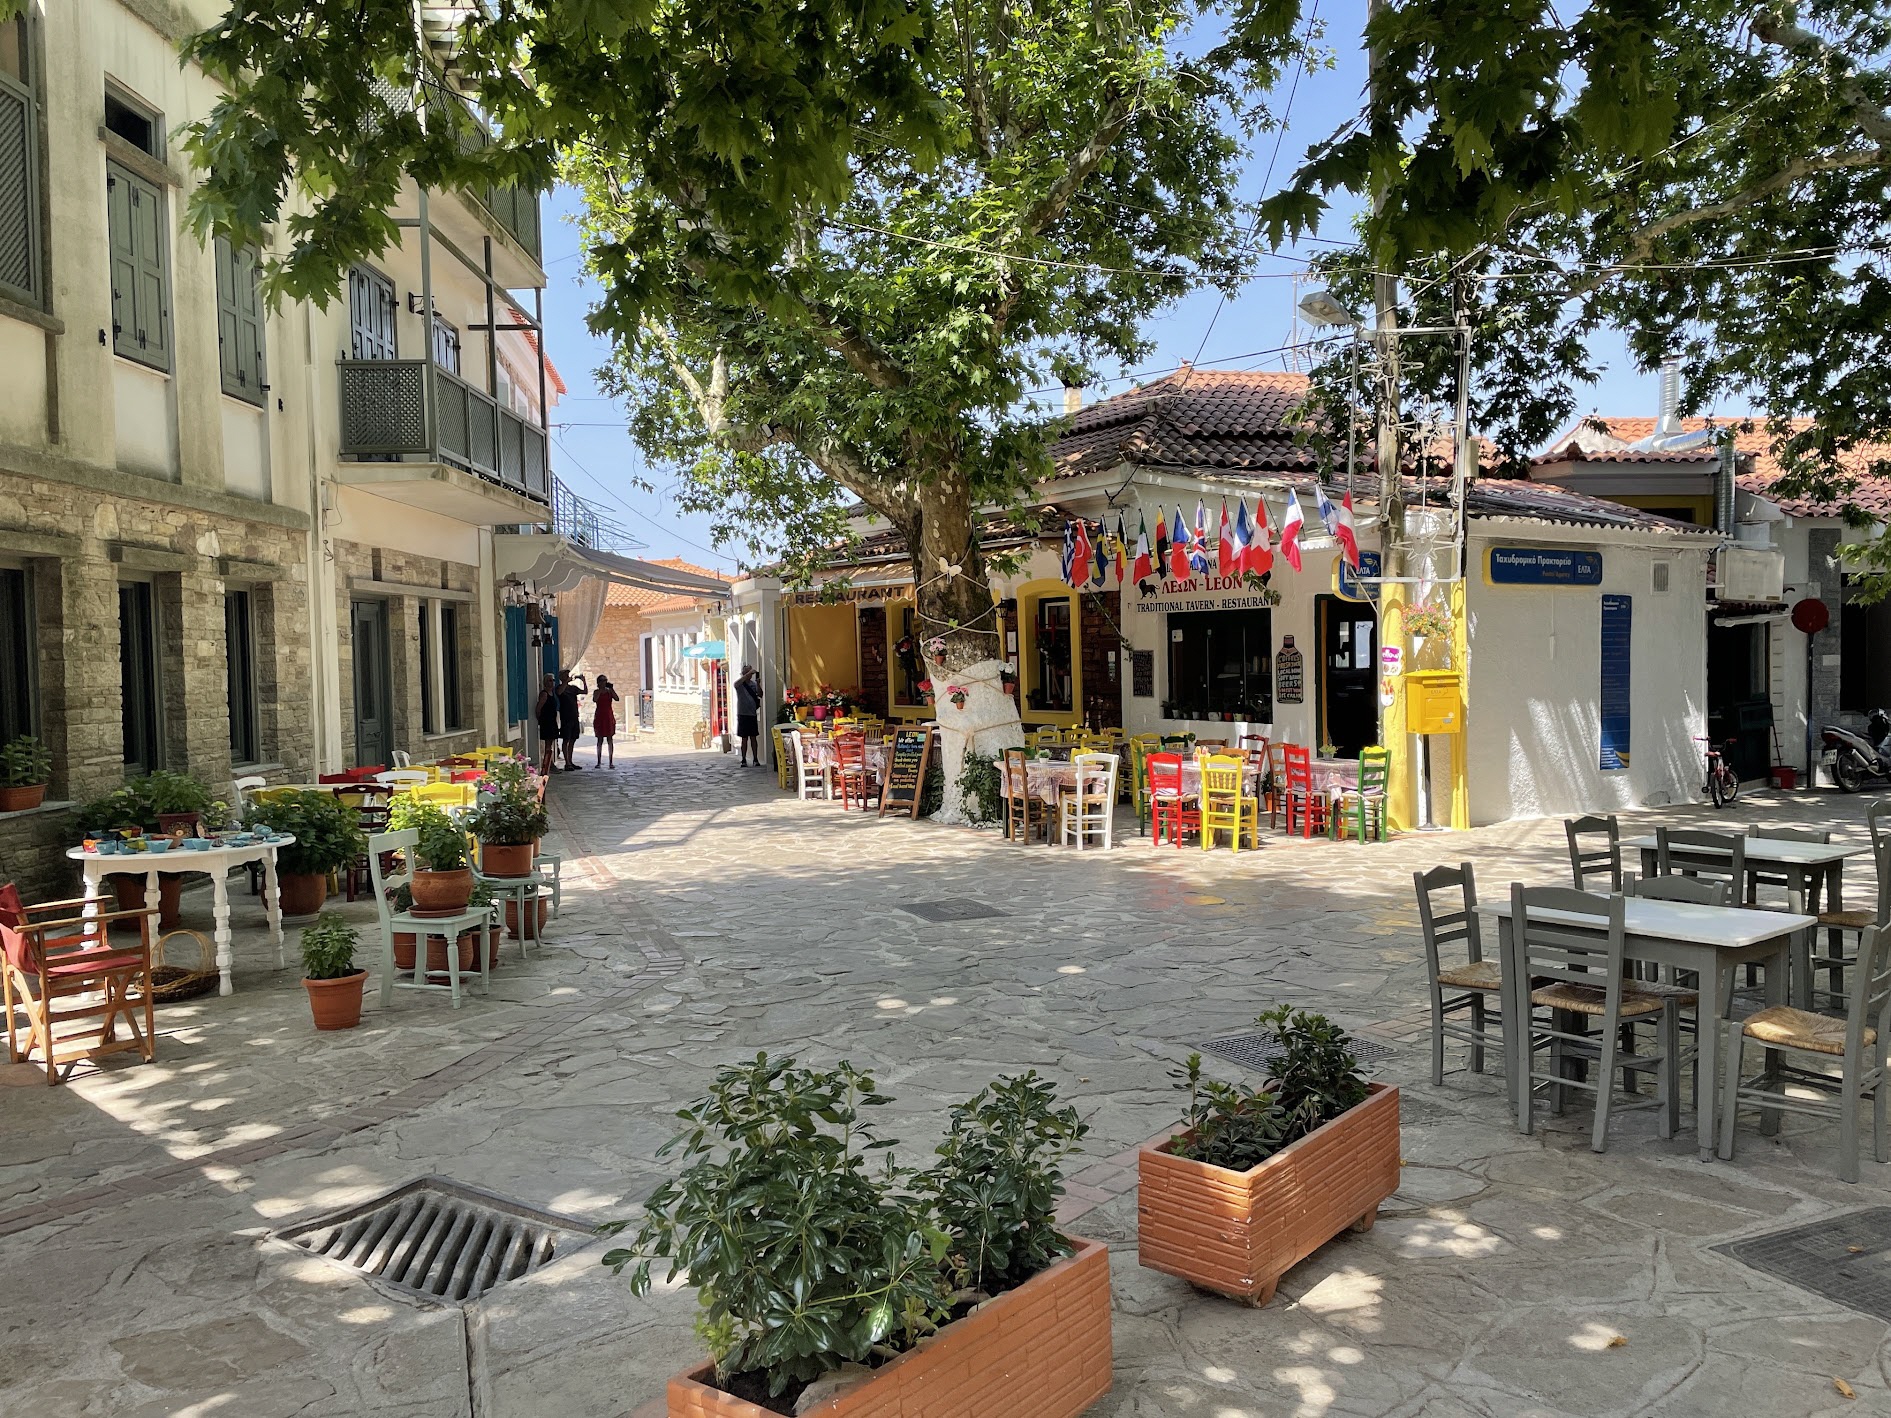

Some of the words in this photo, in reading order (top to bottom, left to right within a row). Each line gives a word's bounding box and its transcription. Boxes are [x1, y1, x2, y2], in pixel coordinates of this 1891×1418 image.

[1496, 554, 1536, 566] Ταχυδρομικό
[1537, 555, 1572, 568] Πρακτορείο
[1577, 565, 1591, 574] ΕΛΤΑ
[1162, 579, 1198, 594] ΛΕΩΝ
[1205, 575, 1243, 591] LEON
[795, 586, 904, 604] RESAURANT
[1136, 601, 1184, 613] TRADITIONAL
[1185, 599, 1215, 610] TAVERN
[1221, 596, 1273, 608] RESTAURANT
